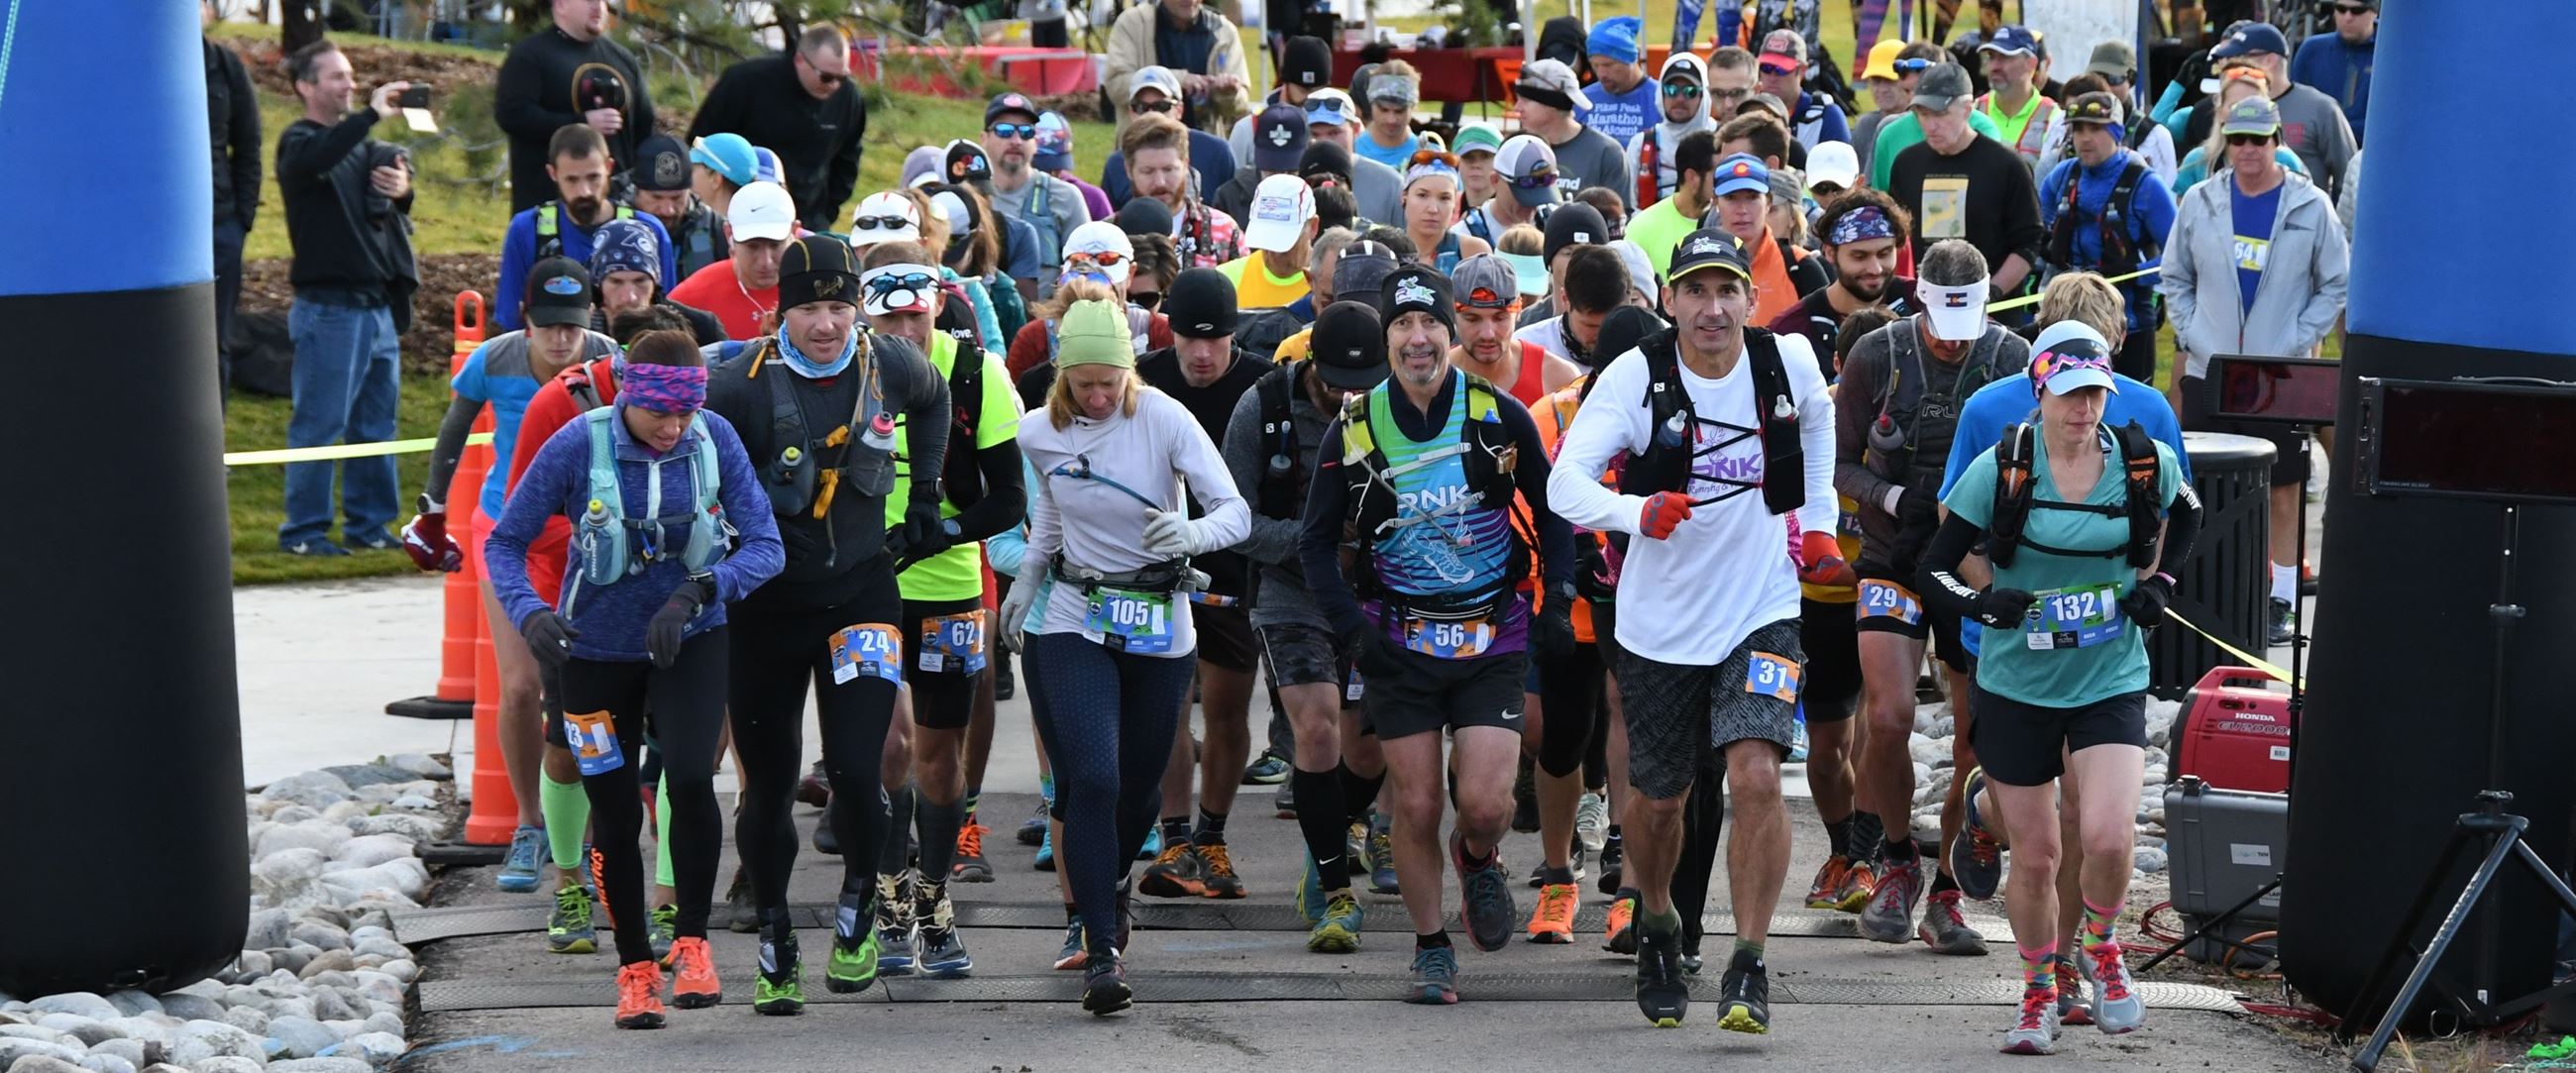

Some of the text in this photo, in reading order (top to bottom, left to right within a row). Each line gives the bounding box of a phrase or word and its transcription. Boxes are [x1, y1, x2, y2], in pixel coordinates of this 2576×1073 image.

[1587, 113, 1644, 126] Marathon
[1869, 586, 1897, 607] 29
[2051, 591, 2097, 621] 132
[1110, 598, 1148, 626] 105
[859, 630, 891, 654] 24
[952, 620, 976, 646] 62
[1435, 623, 1464, 648] 56
[1759, 661, 1787, 690] 31
[2235, 712, 2276, 722] HONDA
